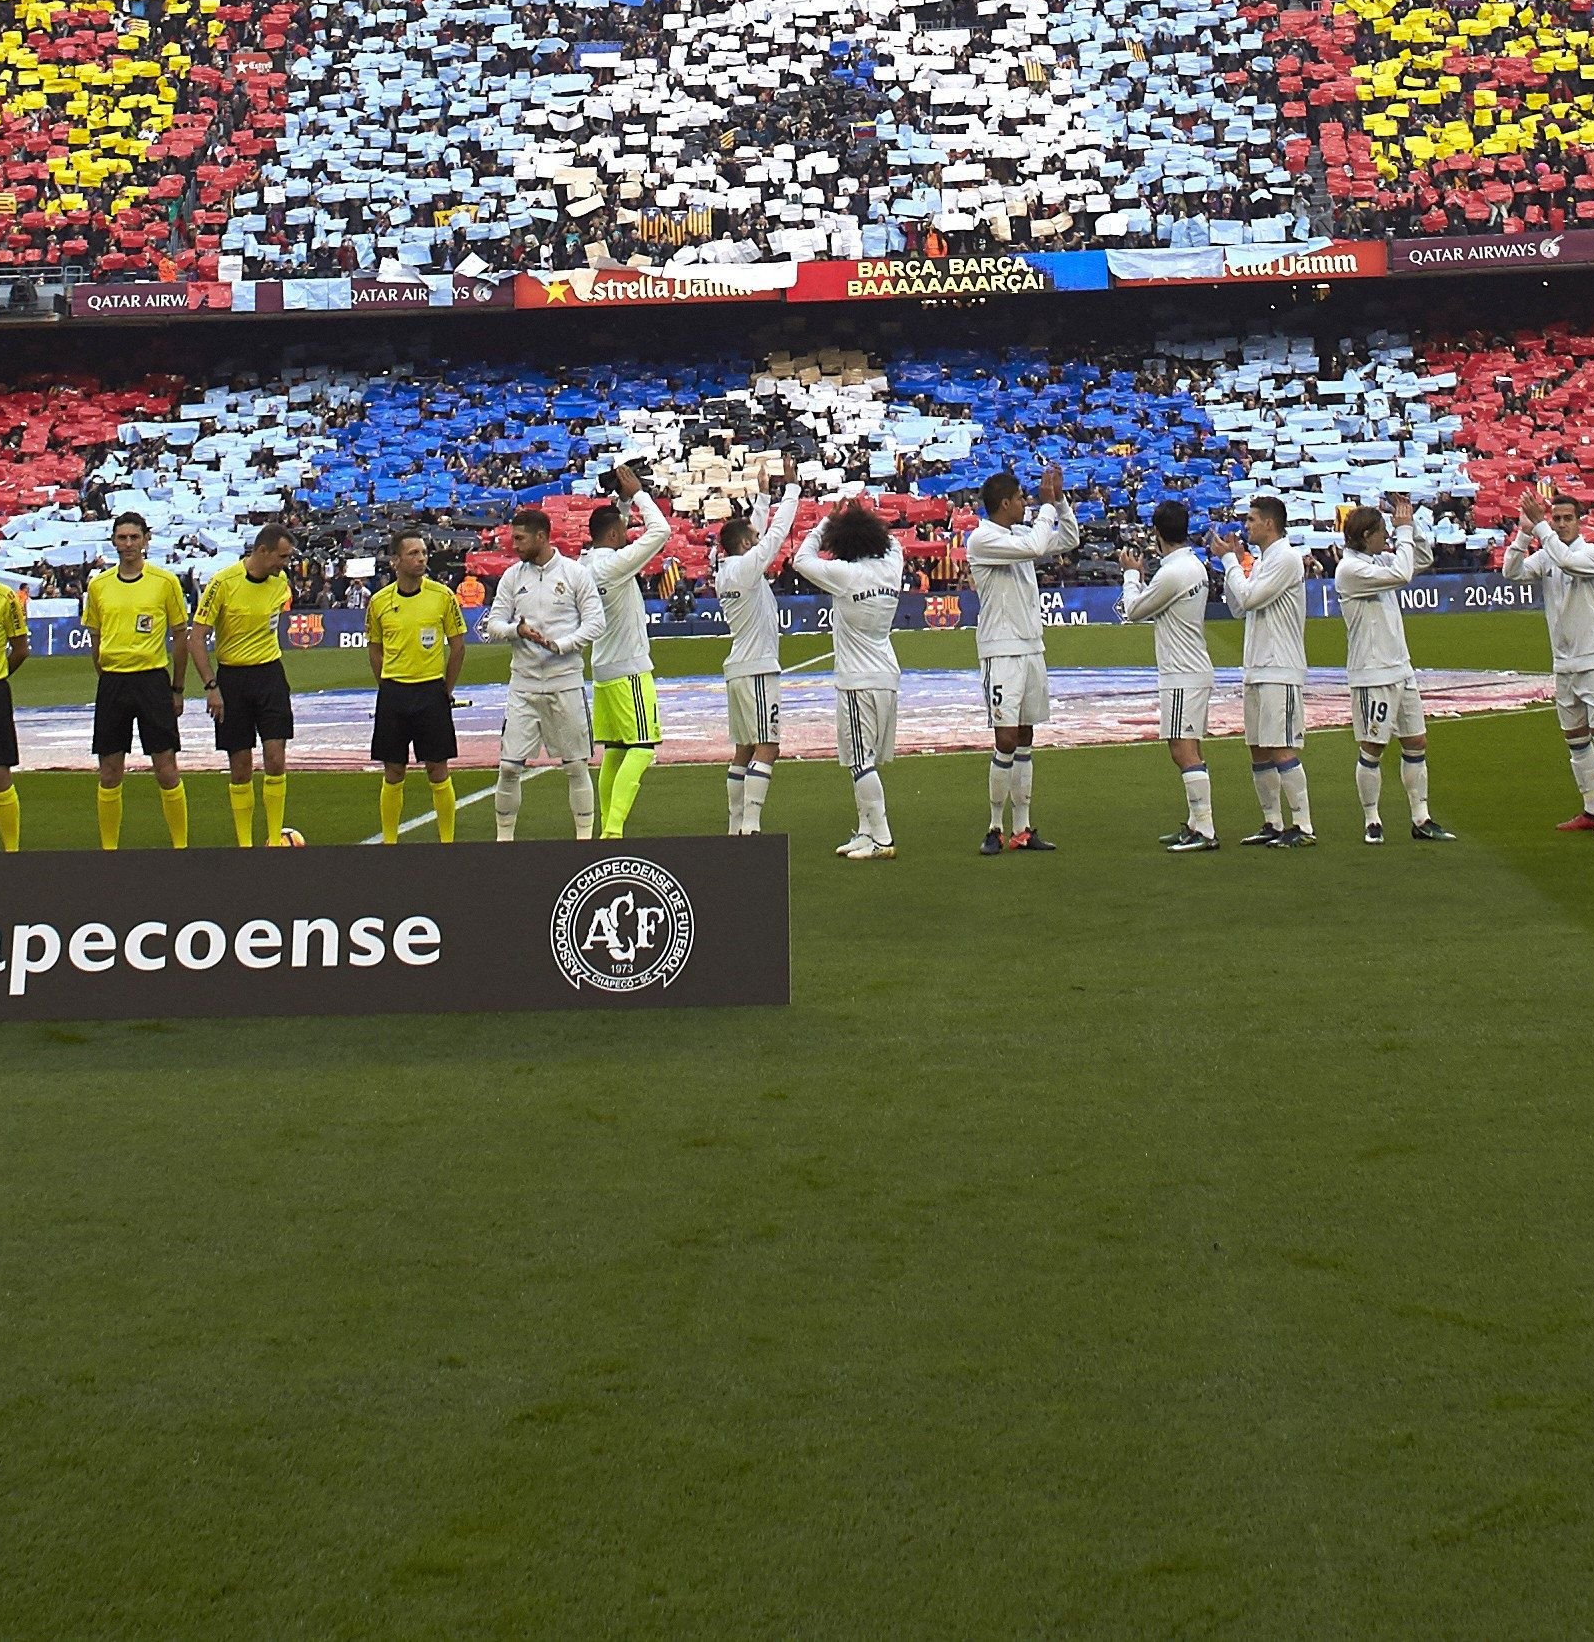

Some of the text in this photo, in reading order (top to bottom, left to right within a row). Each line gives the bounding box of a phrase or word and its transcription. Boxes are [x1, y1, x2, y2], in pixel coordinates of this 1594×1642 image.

[1408, 242, 1537, 264] QATAR AIRWAYS
[857, 256, 1034, 280] BARÇA, BARÇA,
[351, 286, 470, 304] QATAR AIRYS
[588, 275, 670, 302] strella
[87, 294, 142, 310] QATAR
[852, 587, 877, 603] REAL
[1399, 589, 1438, 610] NOU
[1463, 584, 1533, 607] 20:45 H
[992, 684, 1003, 706] 5
[769, 703, 780, 724] 2
[1369, 700, 1389, 723] 19
[555, 861, 689, 976] ASSOCIAÇÃO CHAPECOENSE DE FUTEBOL
[610, 964, 634, 974] 1973
